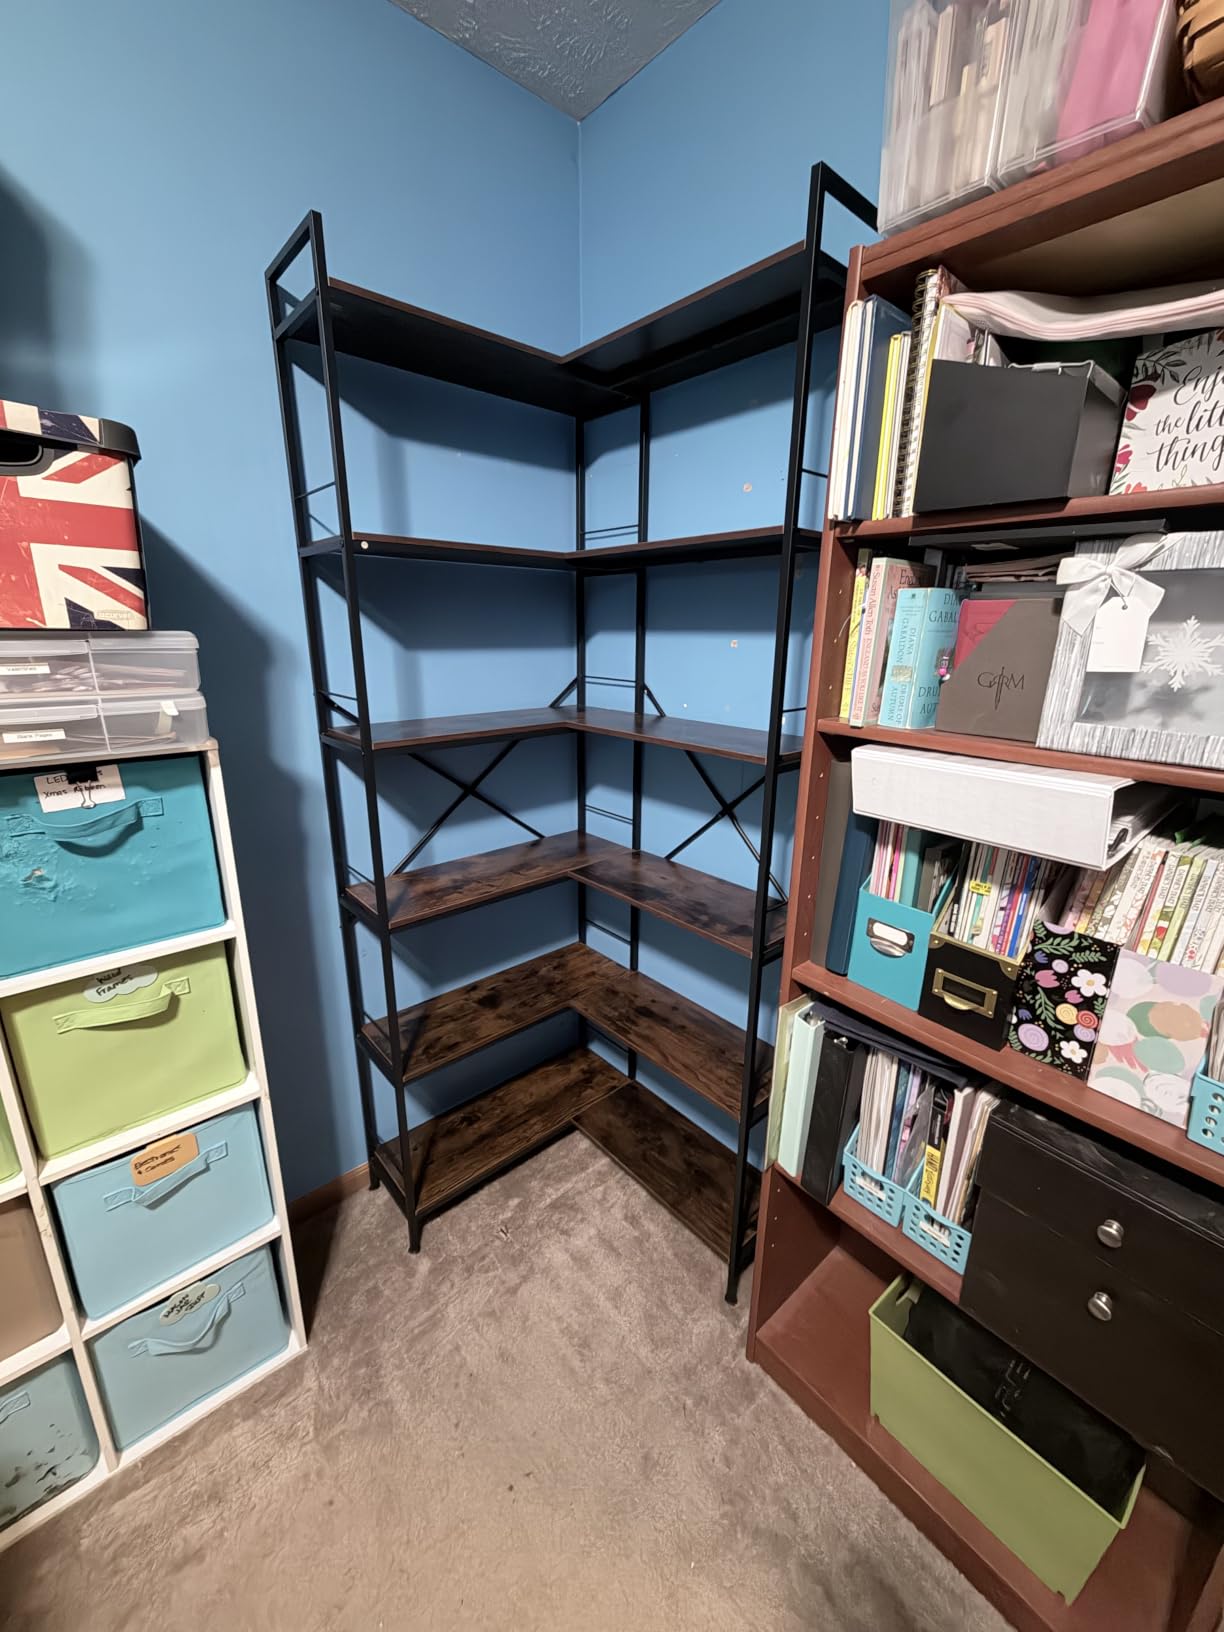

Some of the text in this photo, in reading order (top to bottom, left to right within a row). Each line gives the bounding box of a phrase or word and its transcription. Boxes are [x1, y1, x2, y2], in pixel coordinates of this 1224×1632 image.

[1174, 365, 1224, 405] Enj
[1155, 414, 1185, 436] the
[864, 571, 881, 636] Susan Allen Toth
[895, 617, 909, 664] GABALDON
[906, 627, 917, 656] DIANA
[886, 686, 899, 722] AUTUMN
[96, 974, 133, 996] Frames
